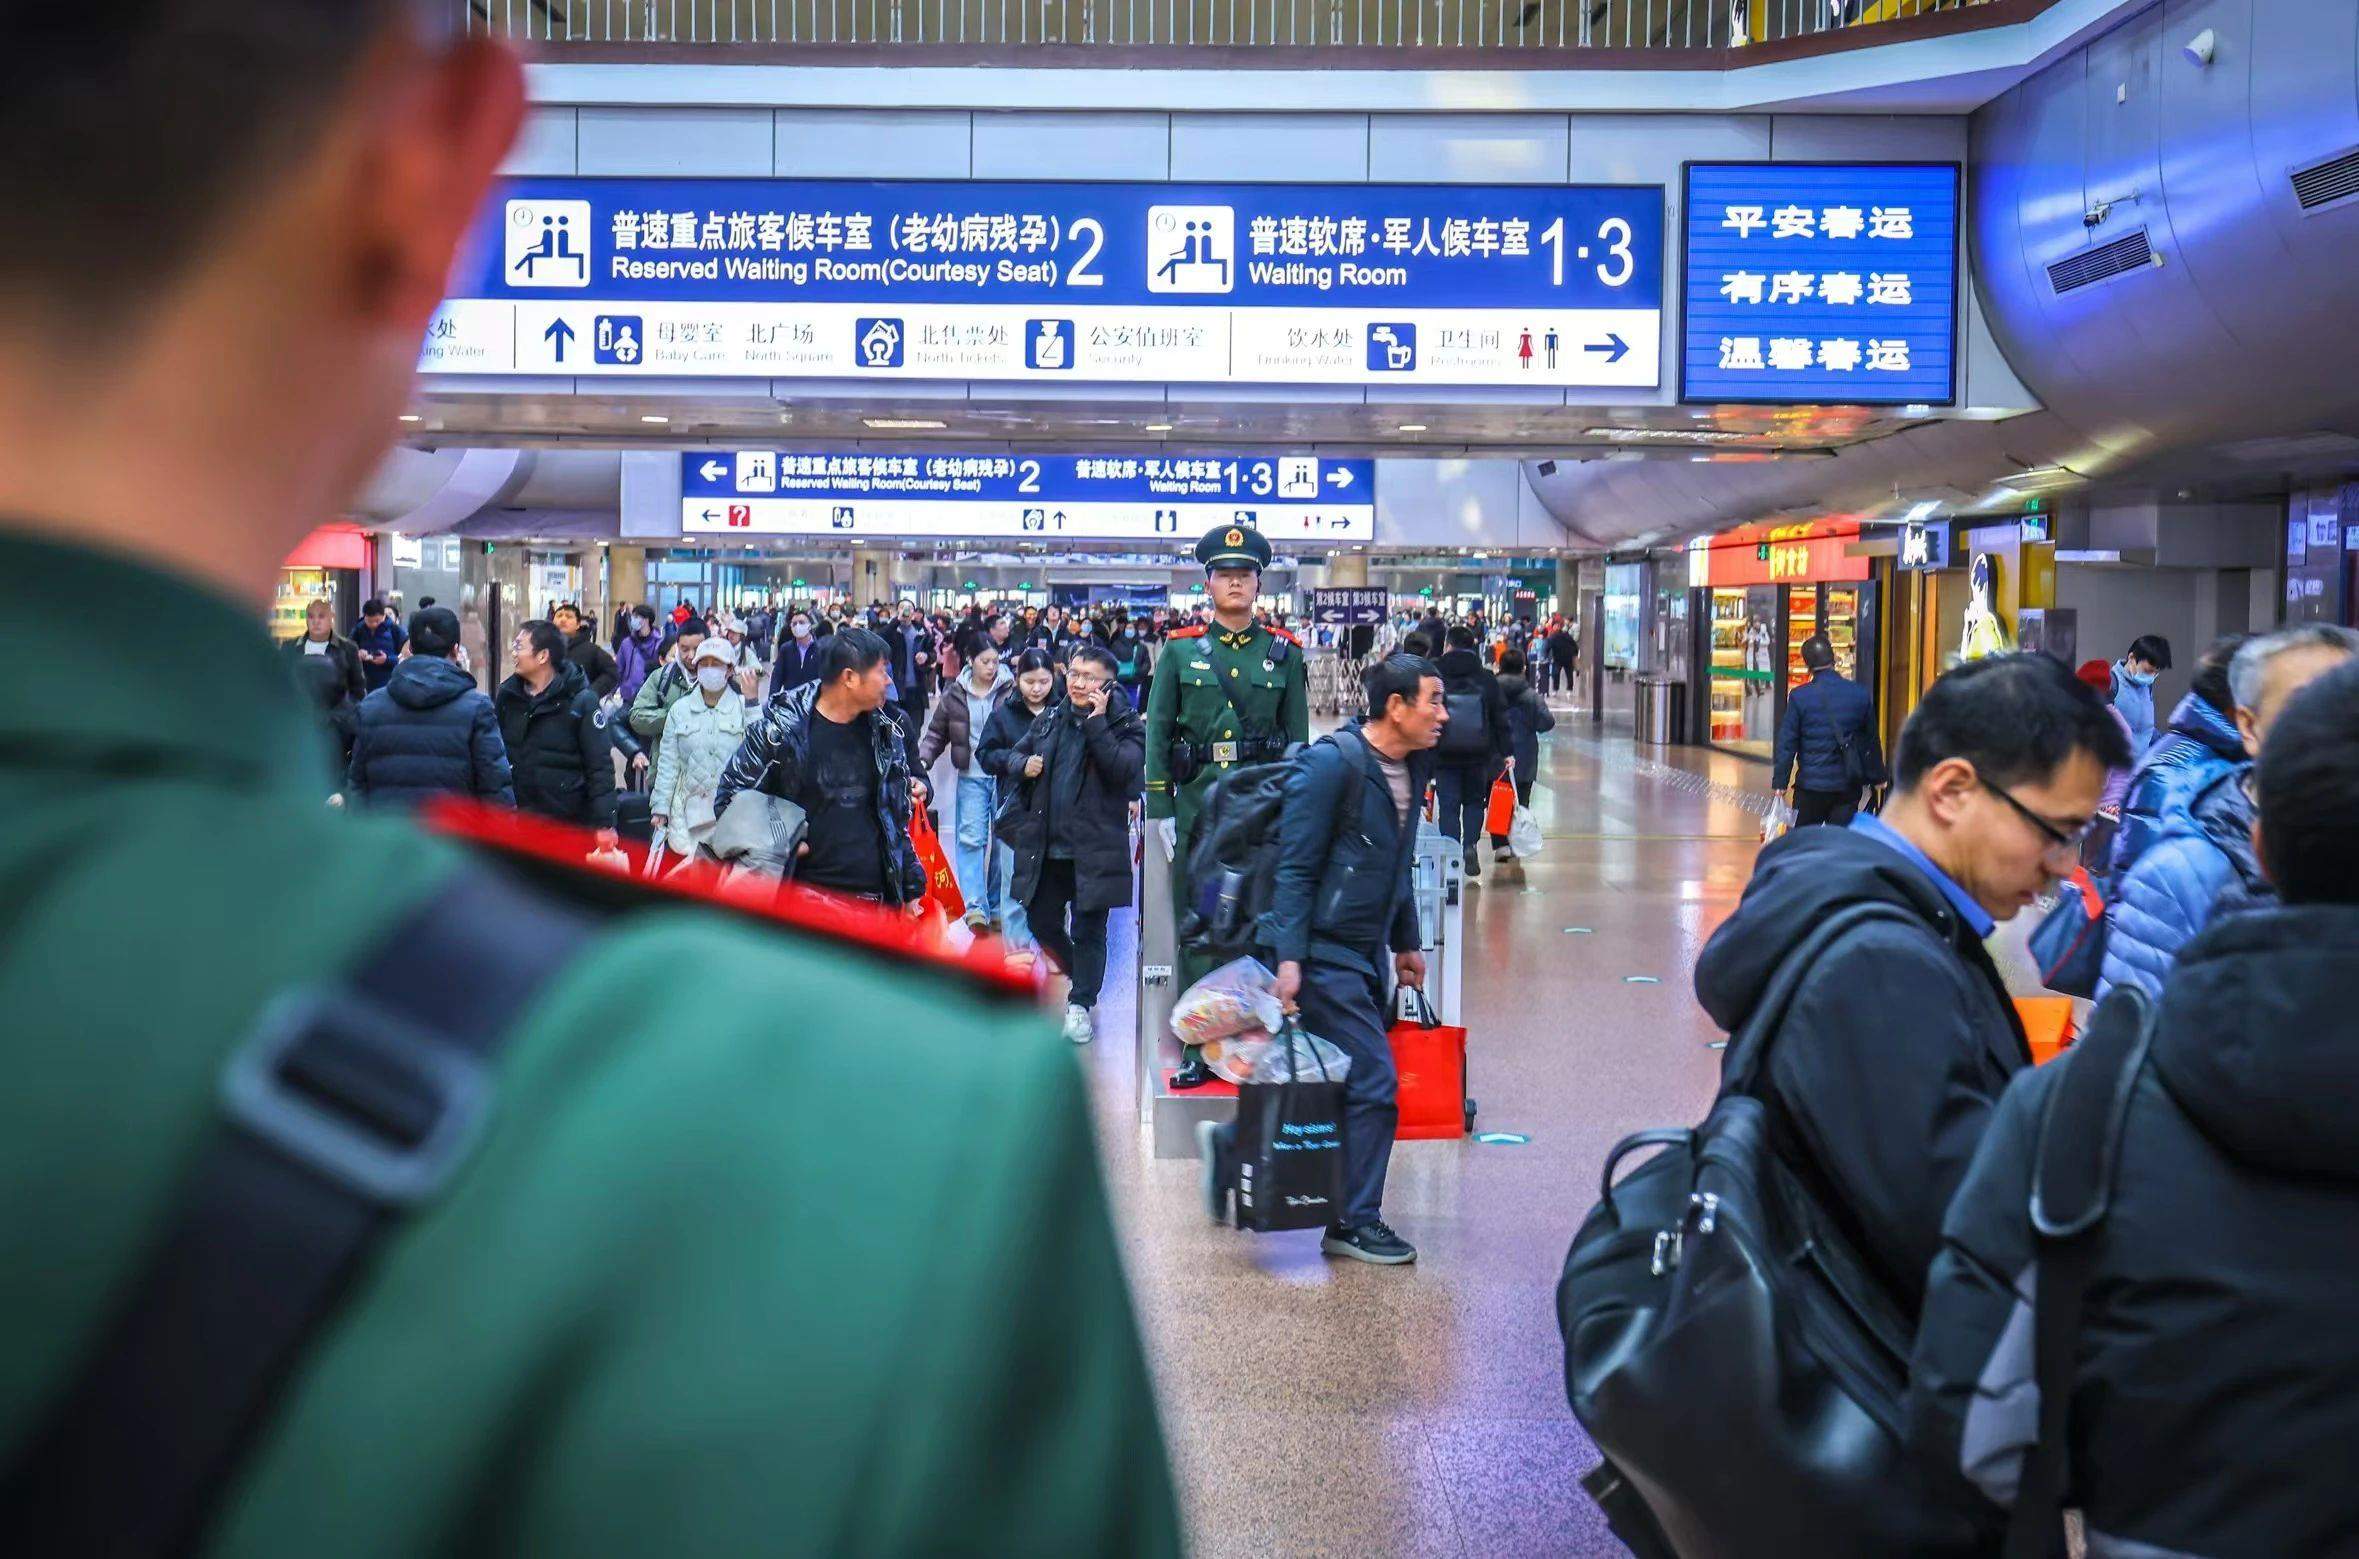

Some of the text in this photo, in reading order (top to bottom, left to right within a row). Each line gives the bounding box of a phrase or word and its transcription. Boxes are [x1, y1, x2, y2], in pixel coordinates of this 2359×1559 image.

[1721, 204, 1914, 240] 平安春运
[1249, 215, 1531, 258] 普速软席·军人候车室
[1066, 217, 1105, 286] 2
[612, 256, 1057, 287] Reserved Waiting Room(Courtesy Seat)
[1249, 262, 1407, 290] Waiting Room
[1719, 270, 1912, 306] 有序春运
[657, 321, 723, 344] 母婴室
[746, 321, 814, 344] 北广场
[1090, 325, 1204, 348] 公安值班室
[1287, 327, 1353, 349] 饮水处
[1435, 329, 1501, 349] 卫生间
[448, 344, 486, 358] Water
[655, 349, 727, 363] Baby Care
[745, 349, 781, 362] North
[1718, 336, 1911, 372] 温馨春运
[780, 477, 830, 490] Reserved
[832, 477, 869, 492] Waiting
[1018, 459, 1042, 494] 2
[1149, 480, 1222, 495] Waiting Room
